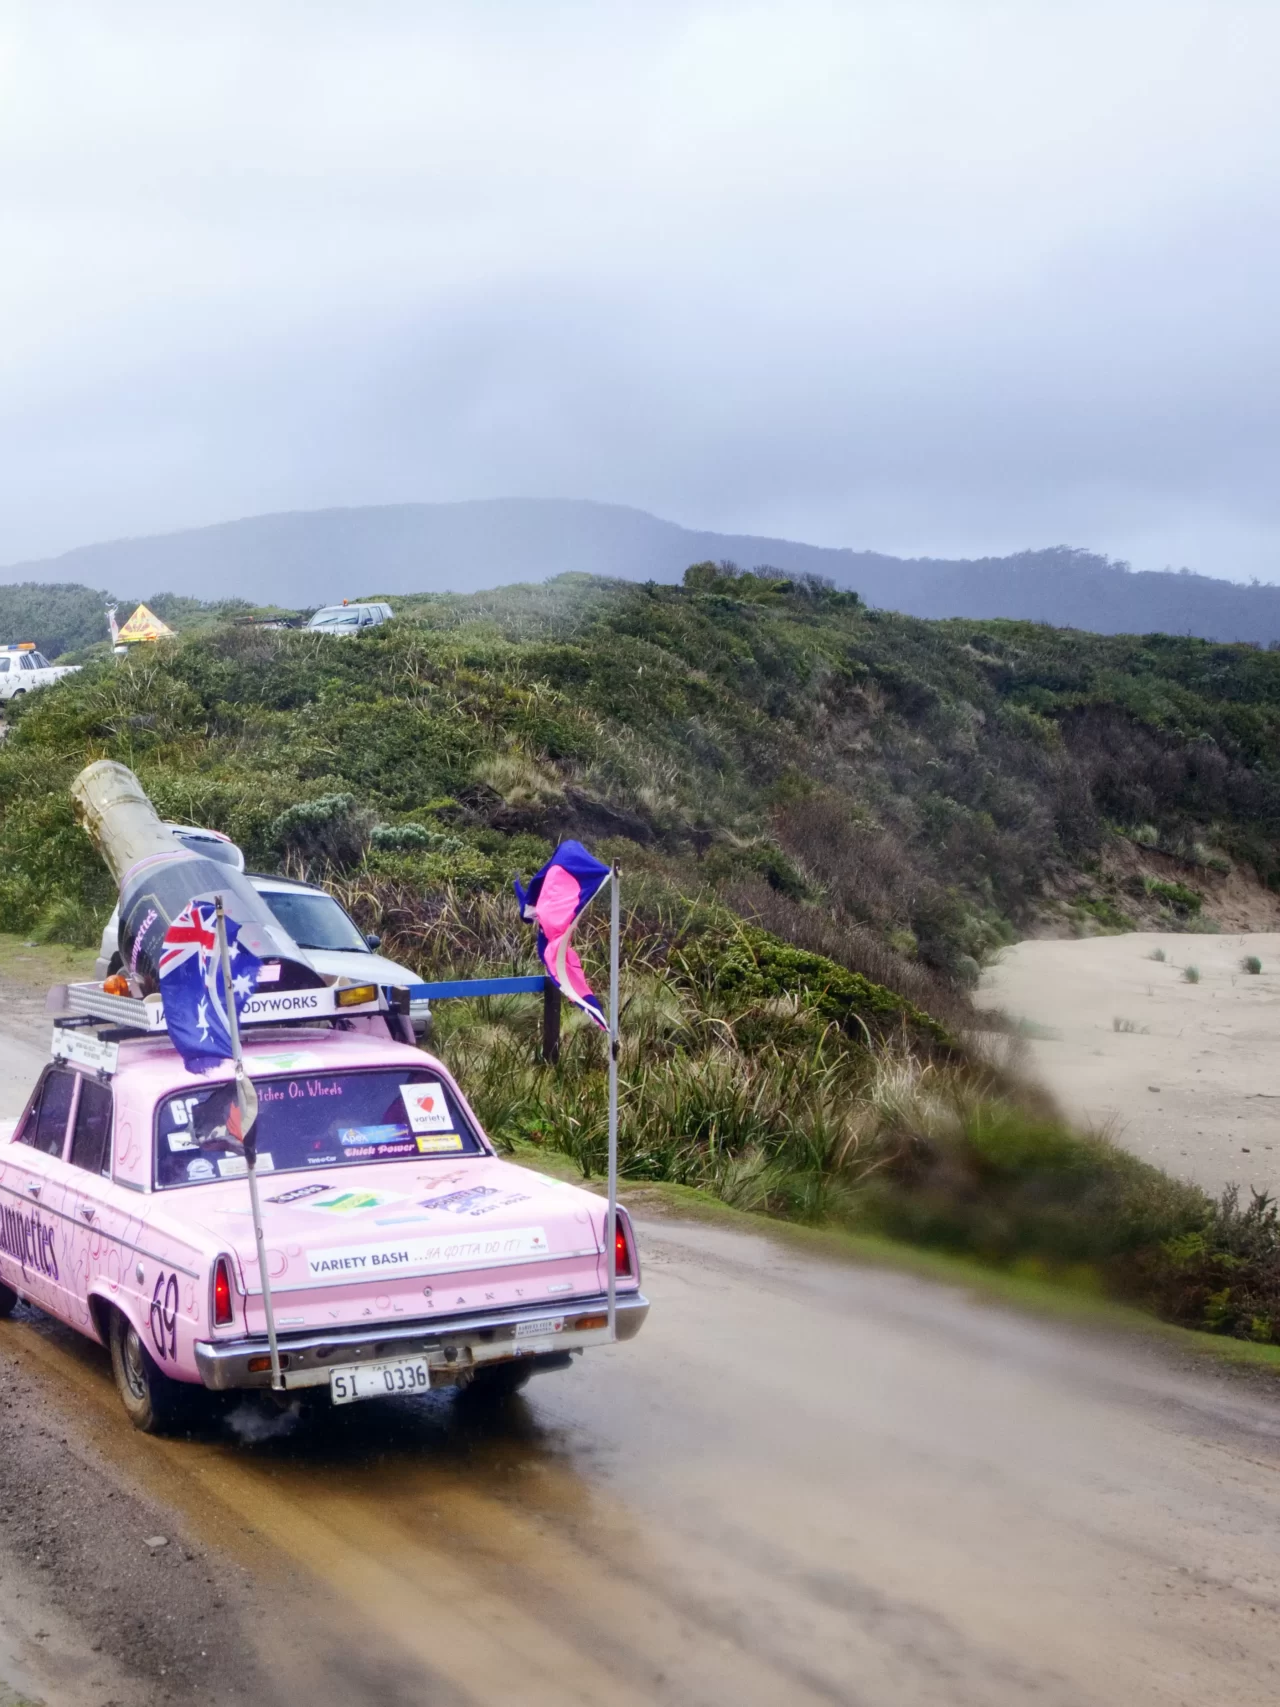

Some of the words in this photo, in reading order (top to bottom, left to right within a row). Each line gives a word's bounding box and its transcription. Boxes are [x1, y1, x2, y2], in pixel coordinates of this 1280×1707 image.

[241, 995, 318, 1014] ODYWORKS
[288, 1082, 305, 1098] On
[306, 1080, 343, 1097] Wheels
[414, 1114, 446, 1123] variety
[341, 1128, 370, 1145] Apex
[344, 1146, 376, 1157] Chick
[378, 1144, 415, 1155] Power
[310, 1256, 368, 1272] VARIETY
[371, 1251, 409, 1266] BASH
[444, 1243, 481, 1260] GOTTA
[484, 1241, 501, 1254] DO
[150, 1271, 179, 1362] 69
[335, 1375, 359, 1398] SI
[383, 1365, 427, 1391] 0336
